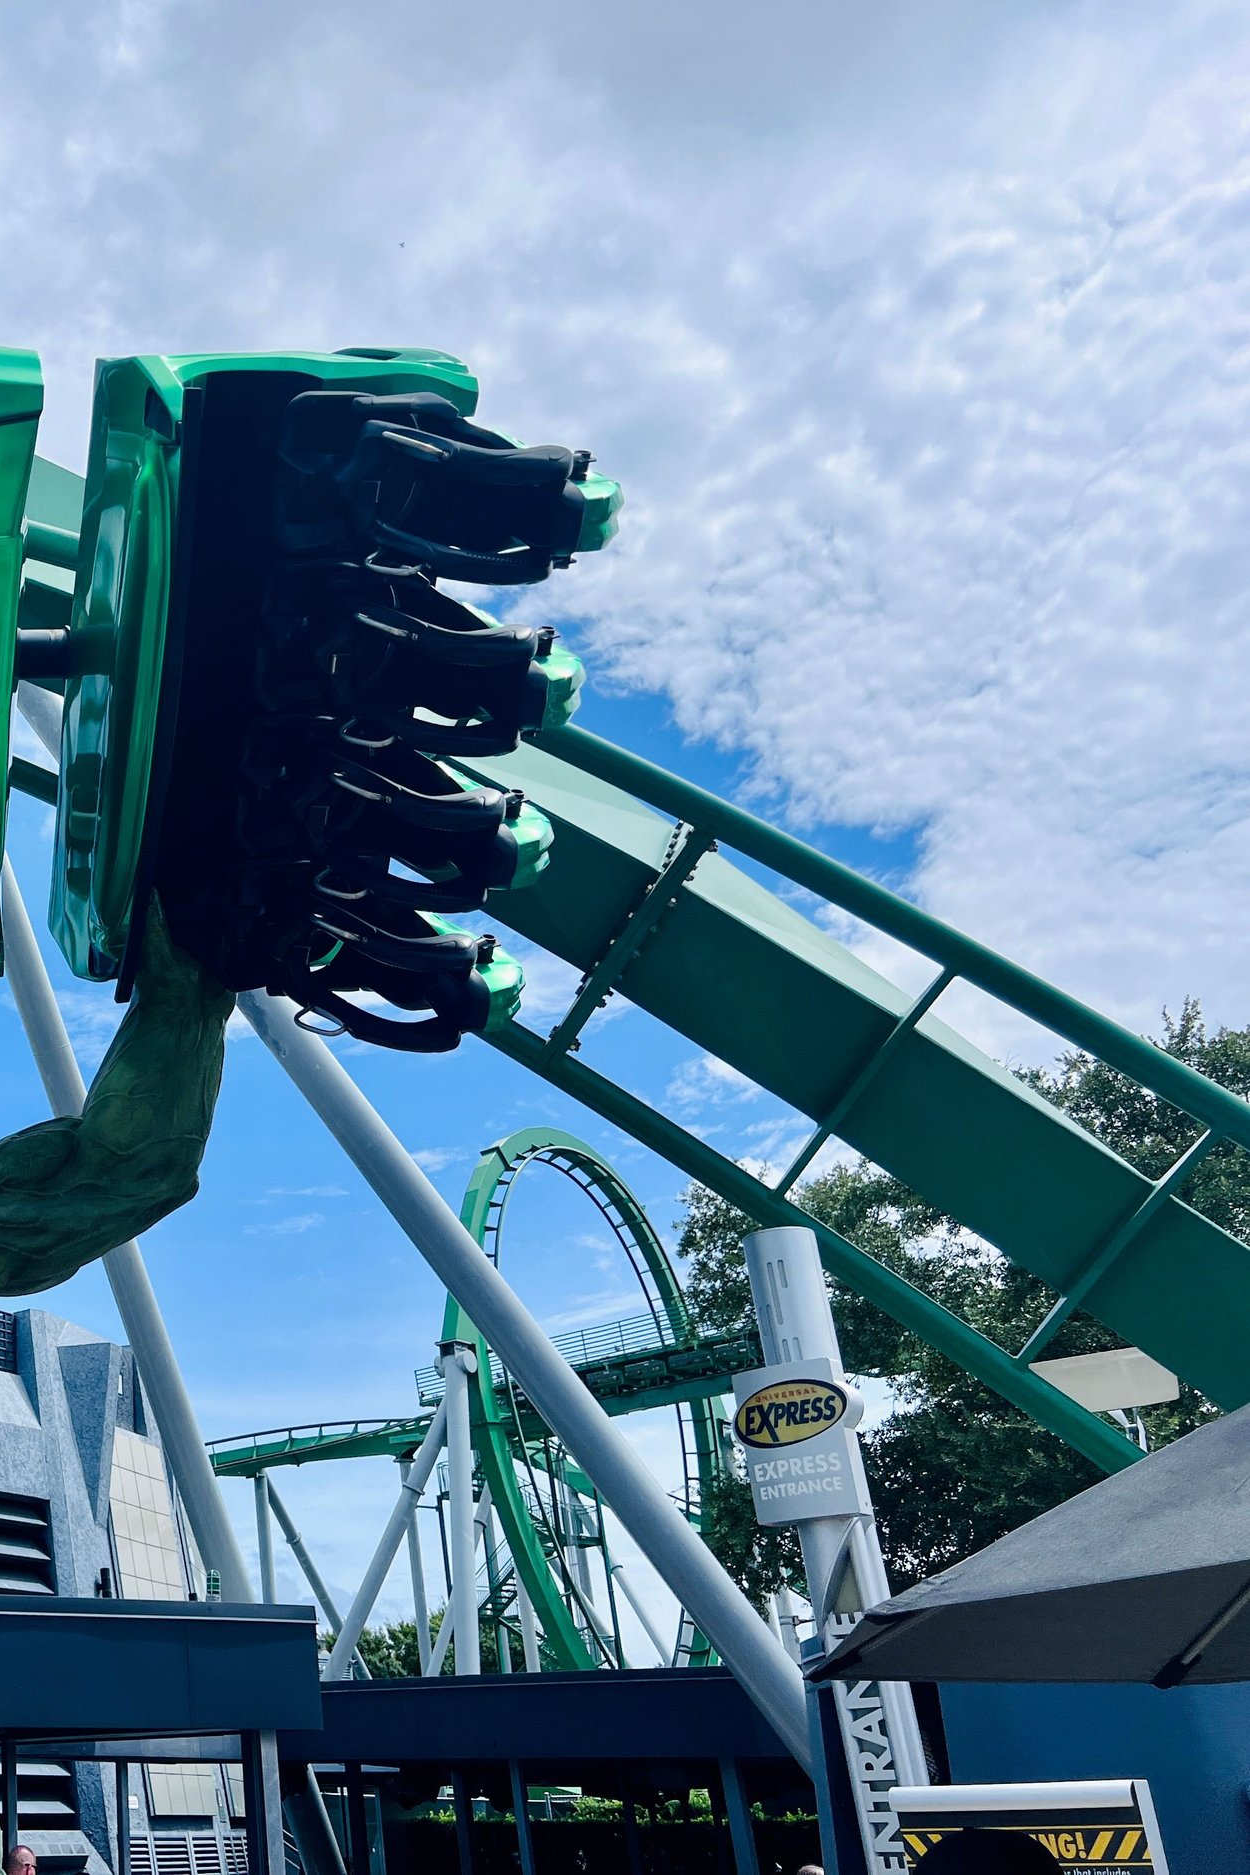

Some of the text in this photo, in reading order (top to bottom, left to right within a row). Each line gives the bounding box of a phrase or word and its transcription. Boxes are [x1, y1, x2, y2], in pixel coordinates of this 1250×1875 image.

[754, 1386, 818, 1403] UNIVERSAL
[744, 1395, 837, 1442] EXPRESS
[753, 1452, 842, 1483] EXPRESS
[759, 1476, 843, 1501] ENTRANCE
[827, 1610, 908, 1875] ENTRANE
